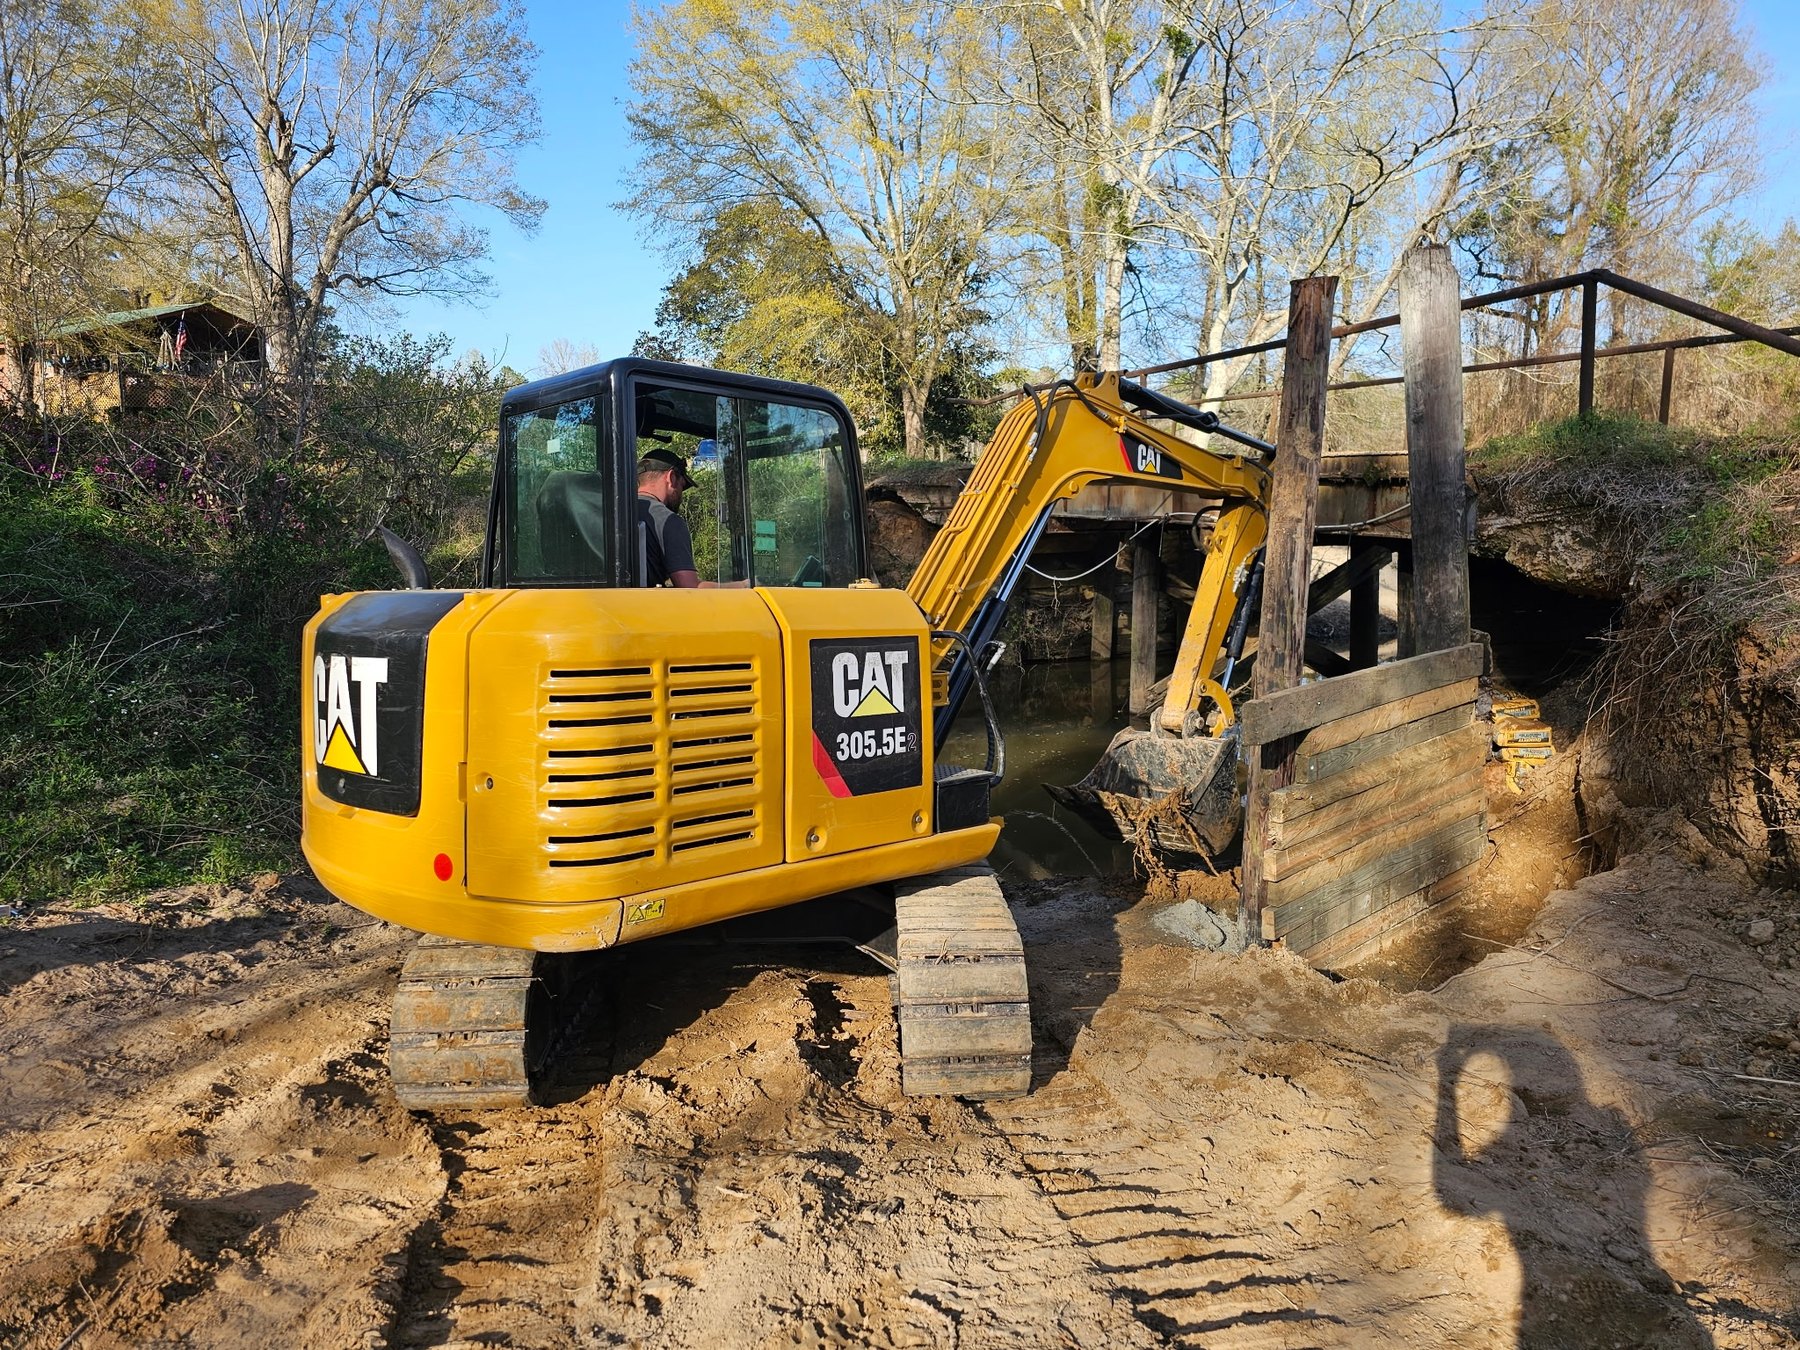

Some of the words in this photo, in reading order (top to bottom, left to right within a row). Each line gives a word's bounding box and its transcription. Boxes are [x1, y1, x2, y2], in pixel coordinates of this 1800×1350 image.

[1137, 443, 1162, 474] CAT
[314, 655, 389, 776] CAT
[832, 650, 909, 718] CAT
